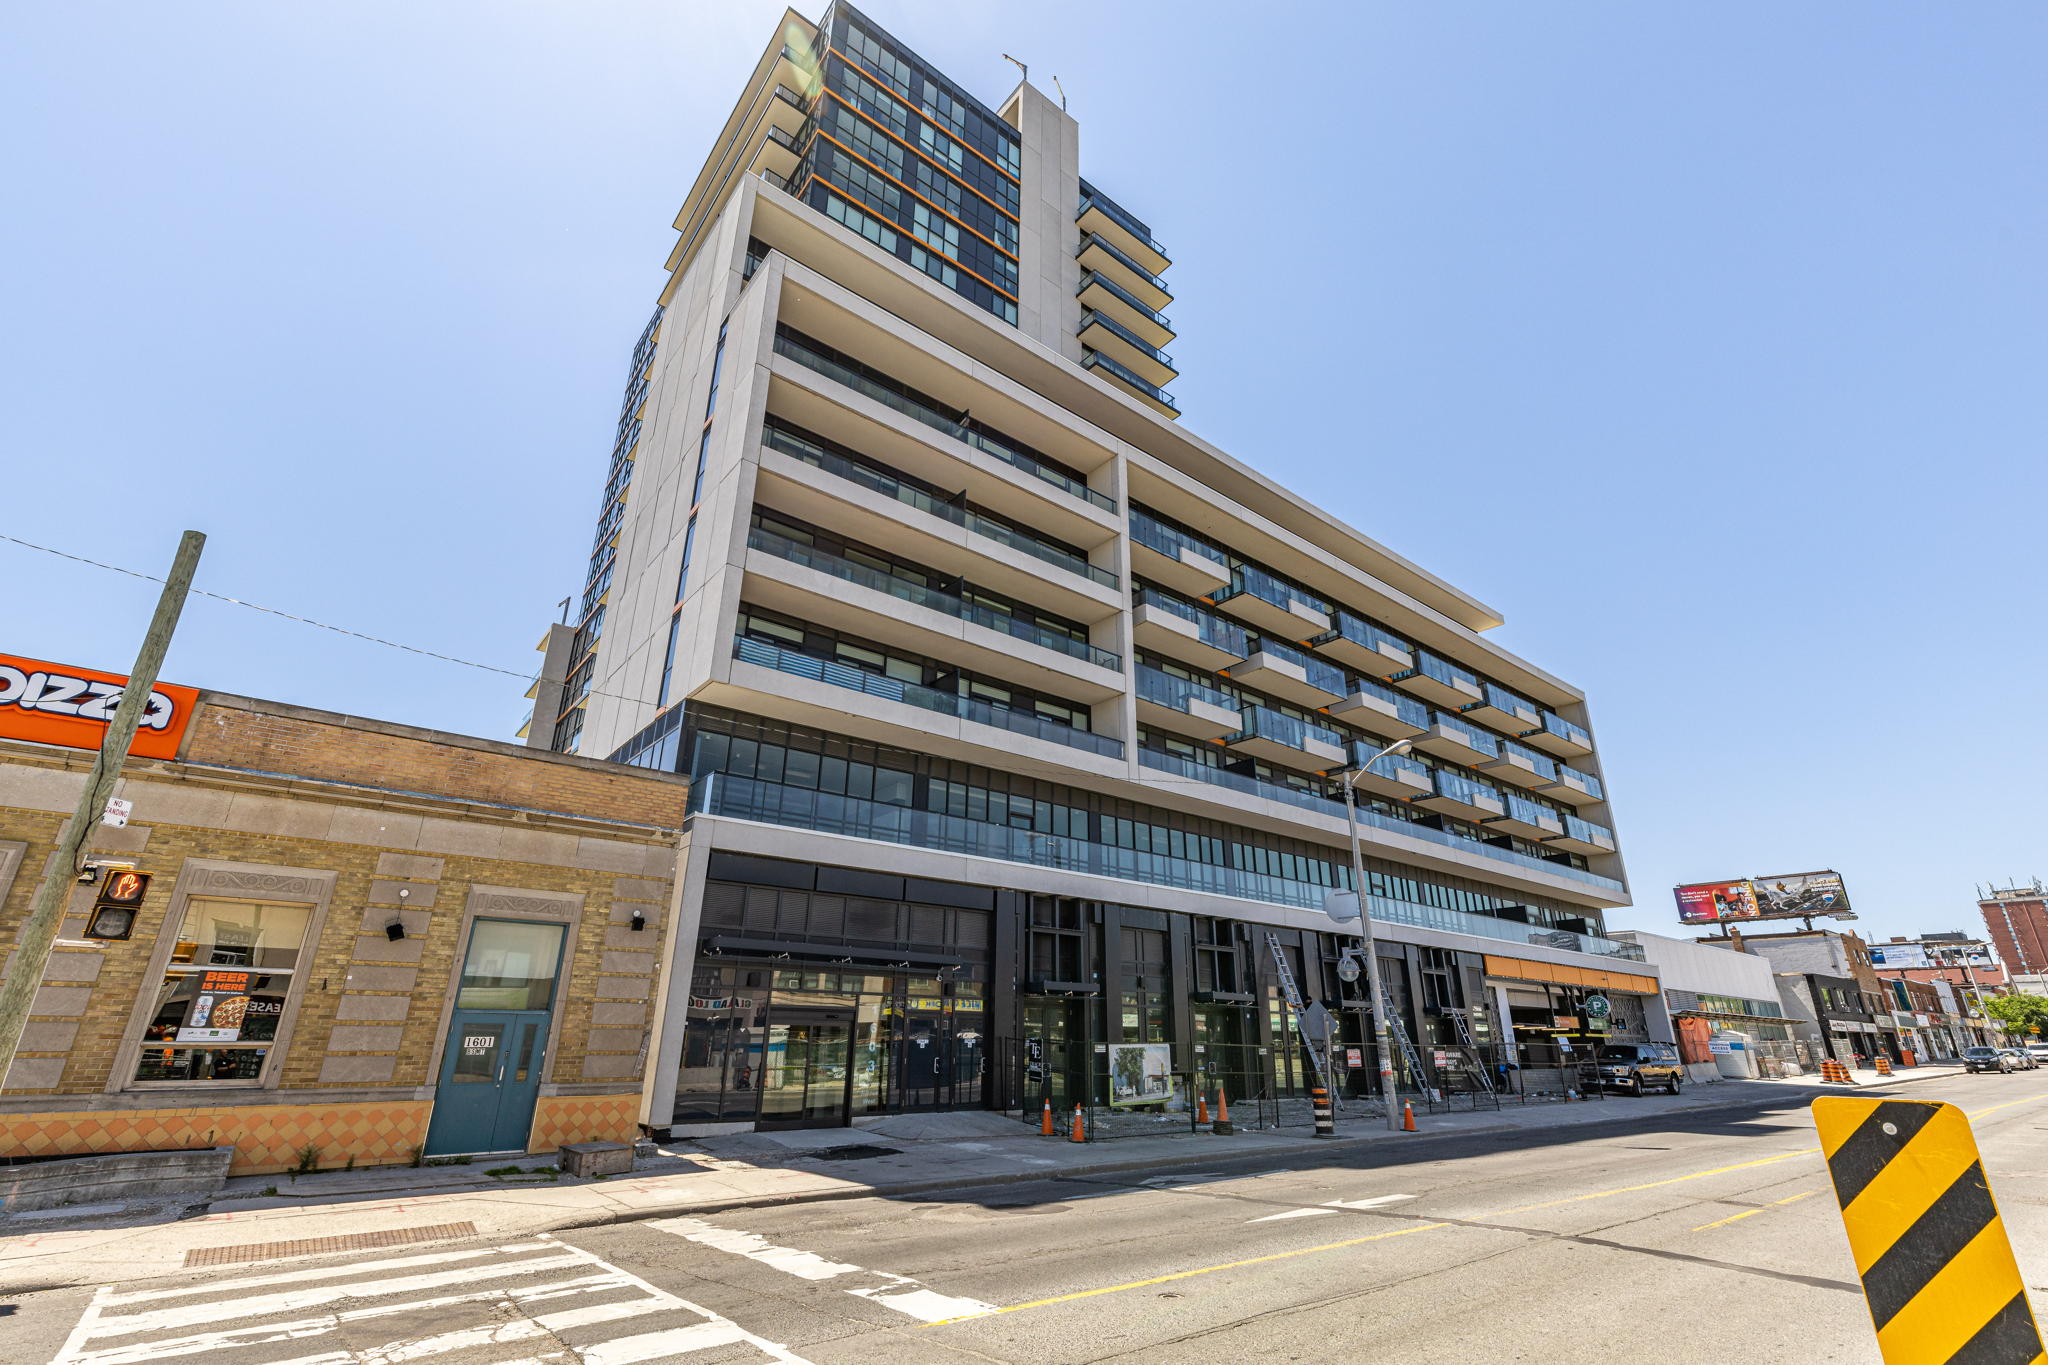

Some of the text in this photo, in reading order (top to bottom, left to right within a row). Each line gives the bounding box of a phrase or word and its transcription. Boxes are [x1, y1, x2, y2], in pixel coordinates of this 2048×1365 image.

[106, 806, 129, 818] TANDING
[204, 971, 249, 982] BEER
[201, 982, 247, 991] IS HERE
[1593, 1001, 1602, 1010] P
[466, 1037, 492, 1047] 1601
